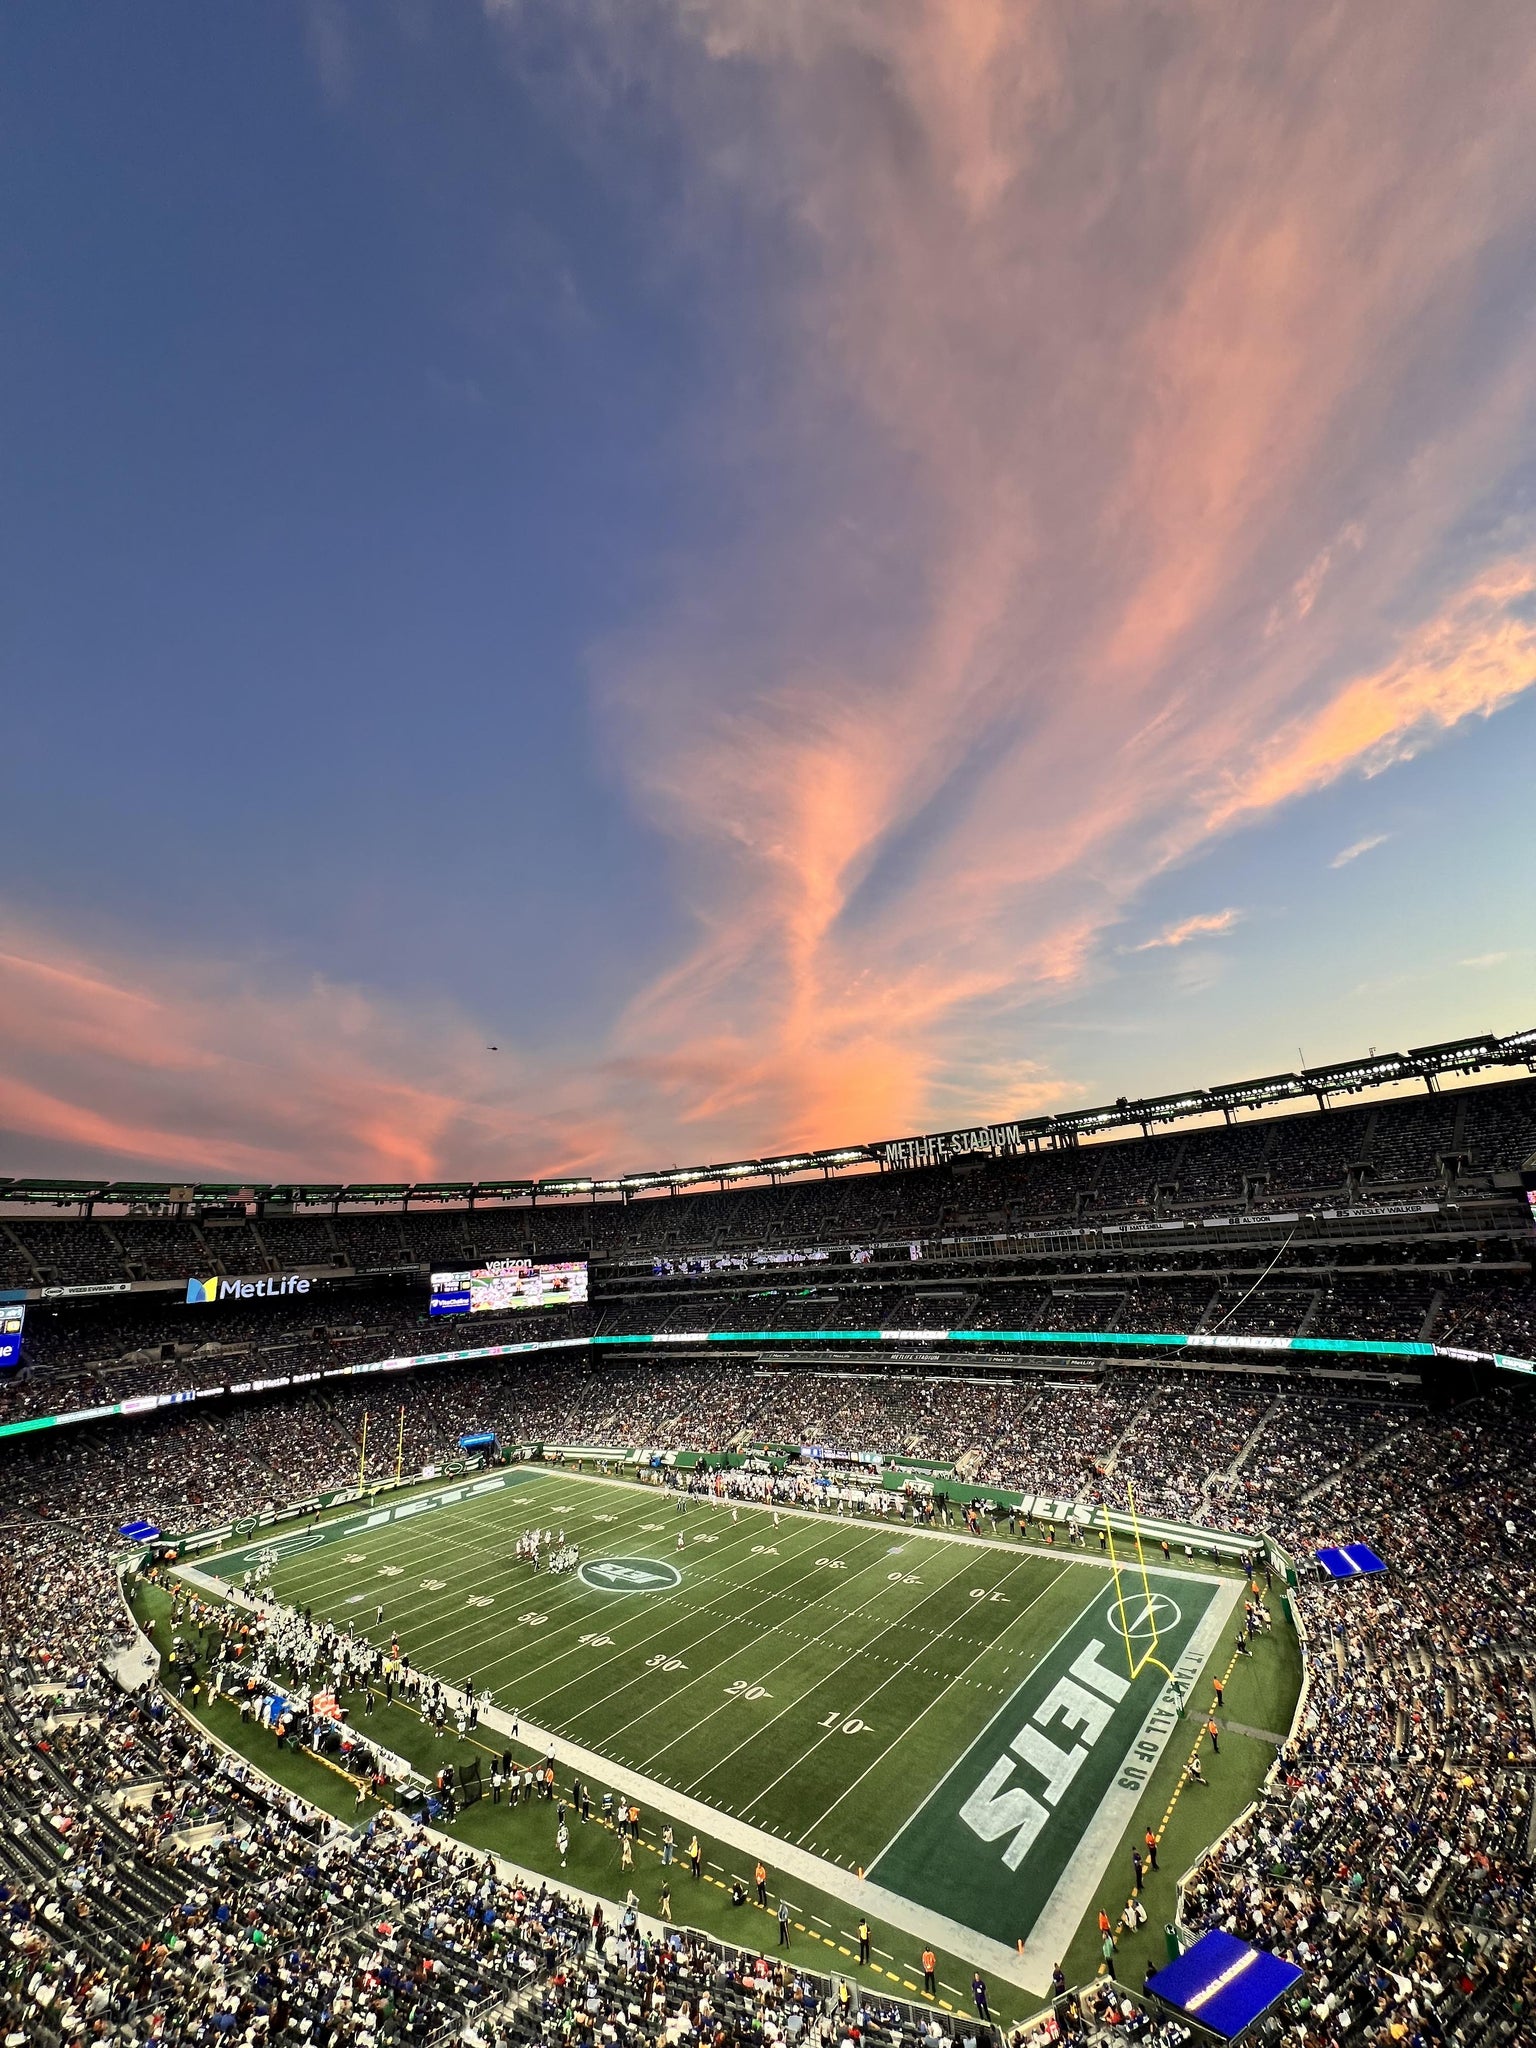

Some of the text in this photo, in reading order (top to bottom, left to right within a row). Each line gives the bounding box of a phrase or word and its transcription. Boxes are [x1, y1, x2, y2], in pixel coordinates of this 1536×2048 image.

[886, 1125, 1021, 1161] METLIFE STADIUM
[1352, 1207, 1385, 1216] WESLEY
[1387, 1205, 1422, 1214] WALKER
[485, 1257, 532, 1271] verizon
[219, 1276, 310, 1300] MetLife
[343, 1477, 507, 1535] JETS
[1010, 1495, 1097, 1524] JETS
[969, 1588, 1005, 1601] 10
[517, 1612, 549, 1625] 50
[577, 1632, 611, 1647] 40
[645, 1654, 682, 1671] 30
[1185, 1651, 1205, 1664] IT
[723, 1680, 766, 1700] 20
[817, 1711, 864, 1734] 10
[1145, 1707, 1175, 1735] ALL
[958, 1638, 1132, 1872] JETS
[1133, 1741, 1160, 1763] OF
[1117, 1766, 1148, 1791] US
